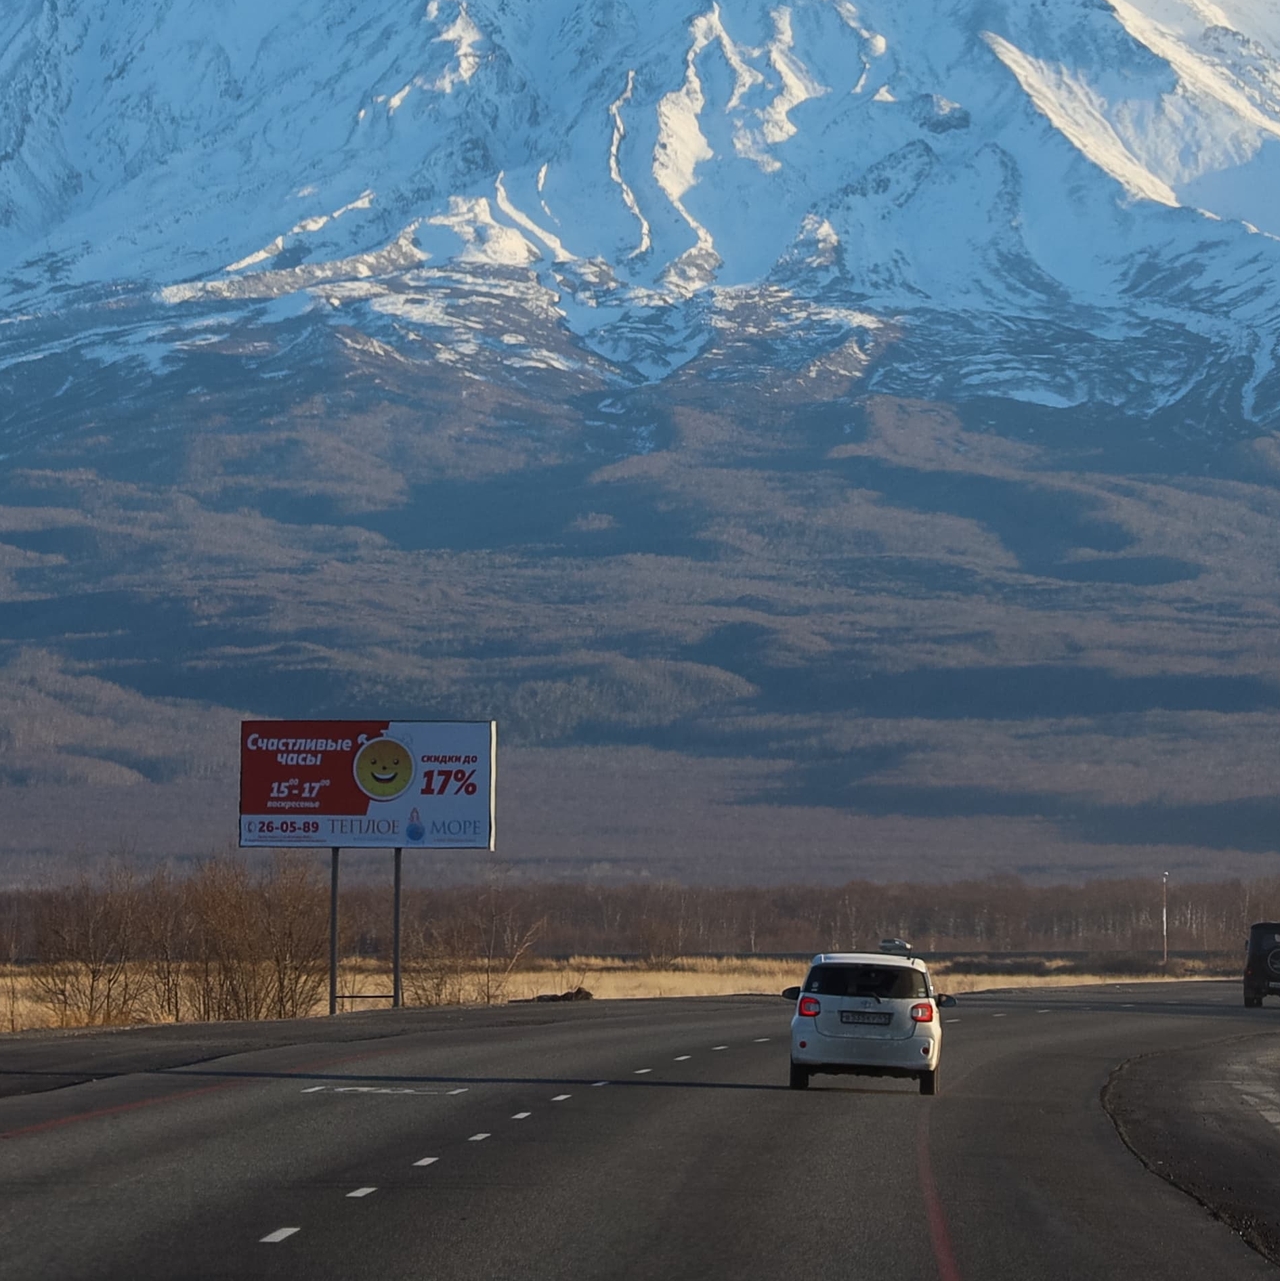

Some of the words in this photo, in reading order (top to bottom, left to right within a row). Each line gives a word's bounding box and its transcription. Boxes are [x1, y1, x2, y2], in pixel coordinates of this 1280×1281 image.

[246, 733, 353, 751] Счастливые
[276, 753, 323, 765] часы
[421, 754, 462, 764] скидки
[462, 755, 478, 764] до
[420, 768, 477, 795] 17%
[266, 801, 321, 809] воскресенье
[258, 820, 320, 833] 26-05-89
[327, 819, 400, 835] ТЕПЛОЕ
[430, 819, 482, 835] МОРЕ
